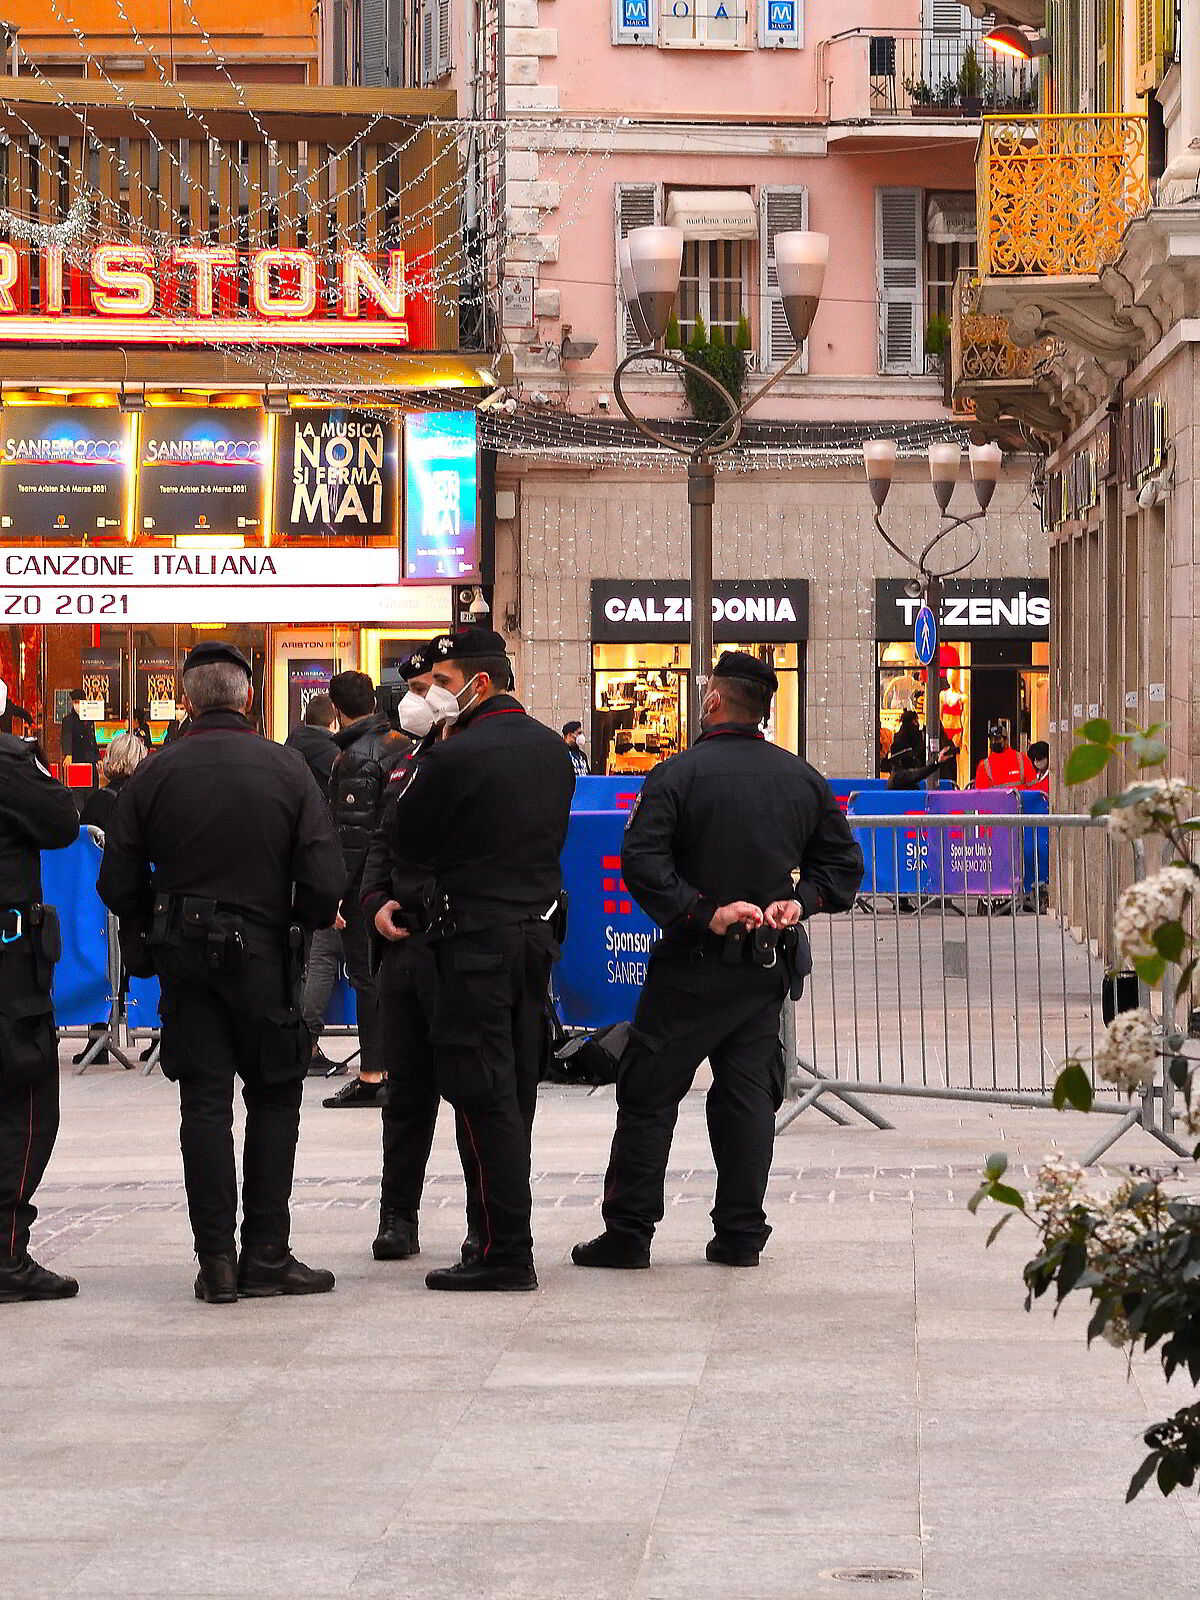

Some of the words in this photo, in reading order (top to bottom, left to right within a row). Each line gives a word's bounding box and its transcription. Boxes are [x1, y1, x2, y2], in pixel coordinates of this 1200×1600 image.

[295, 421, 315, 437] LA
[321, 422, 384, 438] MUSICA
[294, 435, 384, 468] NON
[293, 467, 309, 485] SI
[316, 467, 382, 485] FERMA
[93, 484, 107, 493] 2021
[233, 485, 247, 493] 2021
[290, 484, 382, 523] MAI
[5, 555, 133, 576] CANZONE
[154, 554, 277, 575] ITALIANA
[55, 594, 129, 615] 2021
[895, 591, 1050, 626] TZENIS
[83, 677, 109, 688] NON
[148, 677, 175, 688] NON
[605, 925, 651, 958] Sponsor
